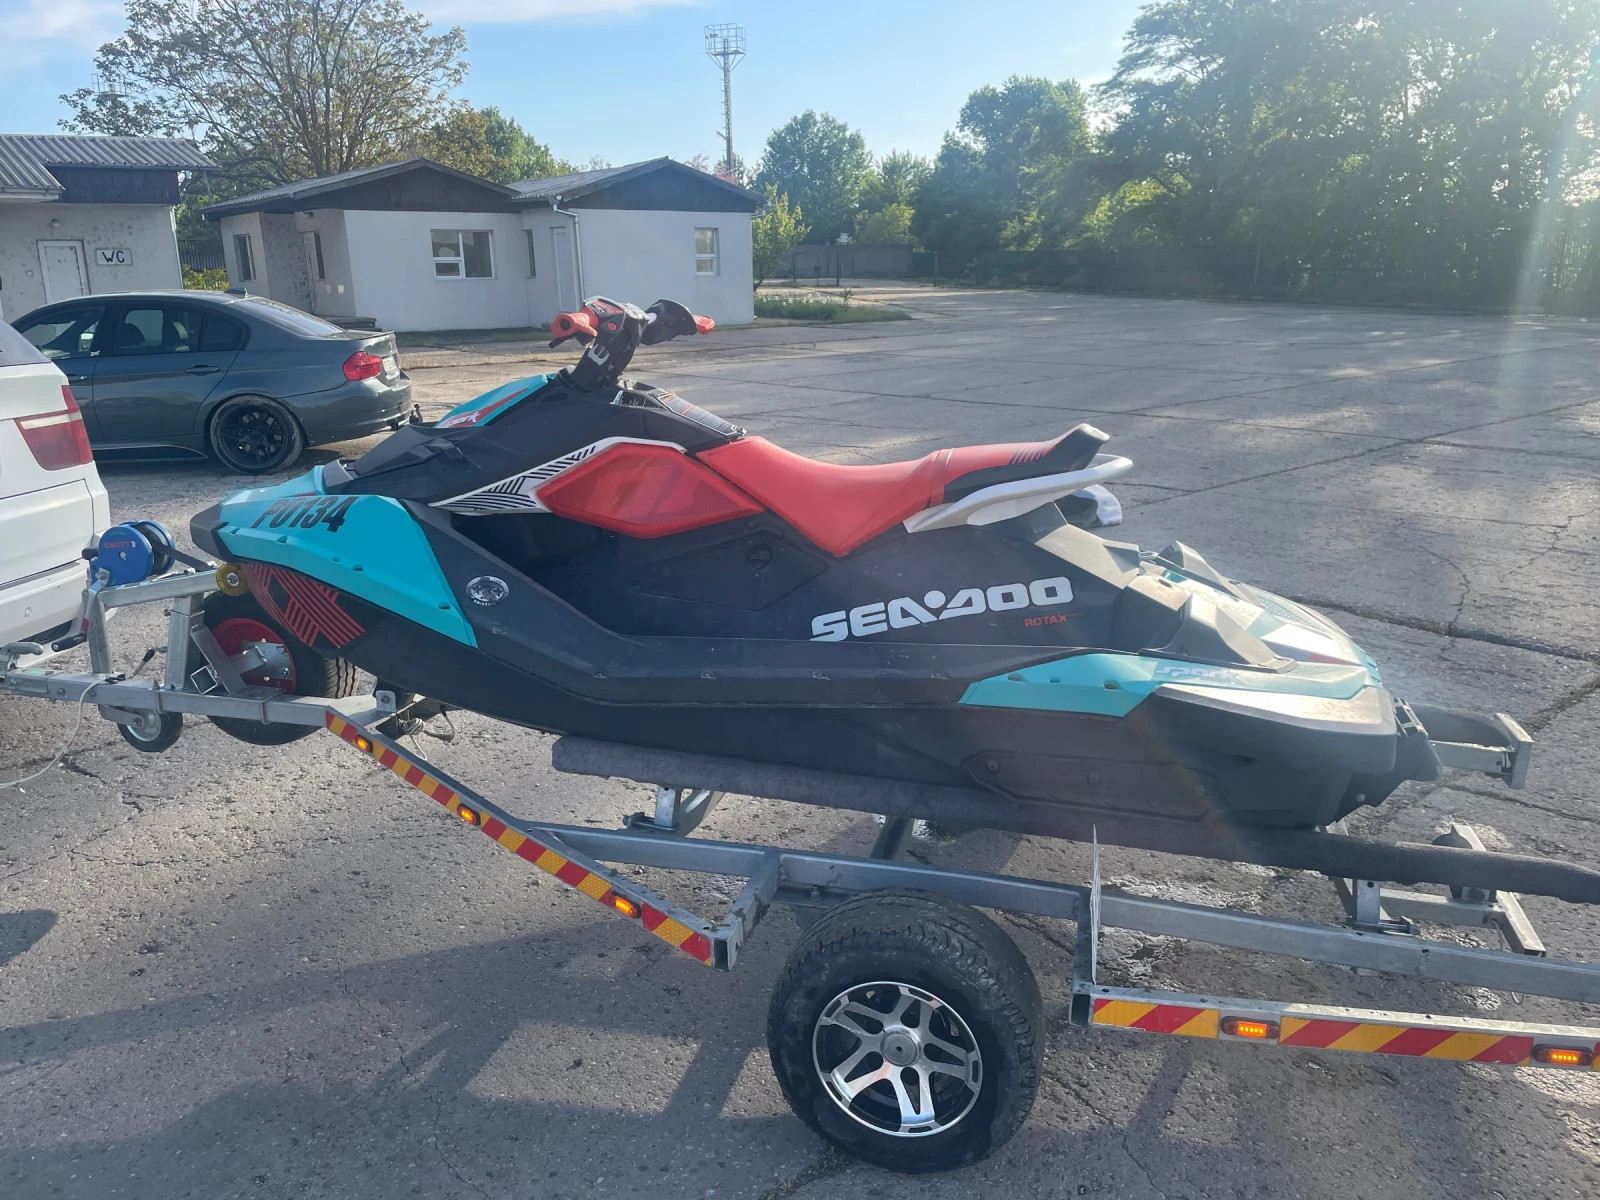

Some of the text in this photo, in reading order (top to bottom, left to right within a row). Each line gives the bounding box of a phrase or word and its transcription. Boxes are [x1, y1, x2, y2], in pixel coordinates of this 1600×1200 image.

[101, 250, 125, 263] WC
[104, 541, 130, 549] KNOTT
[1024, 614, 1067, 627] ROTAX
